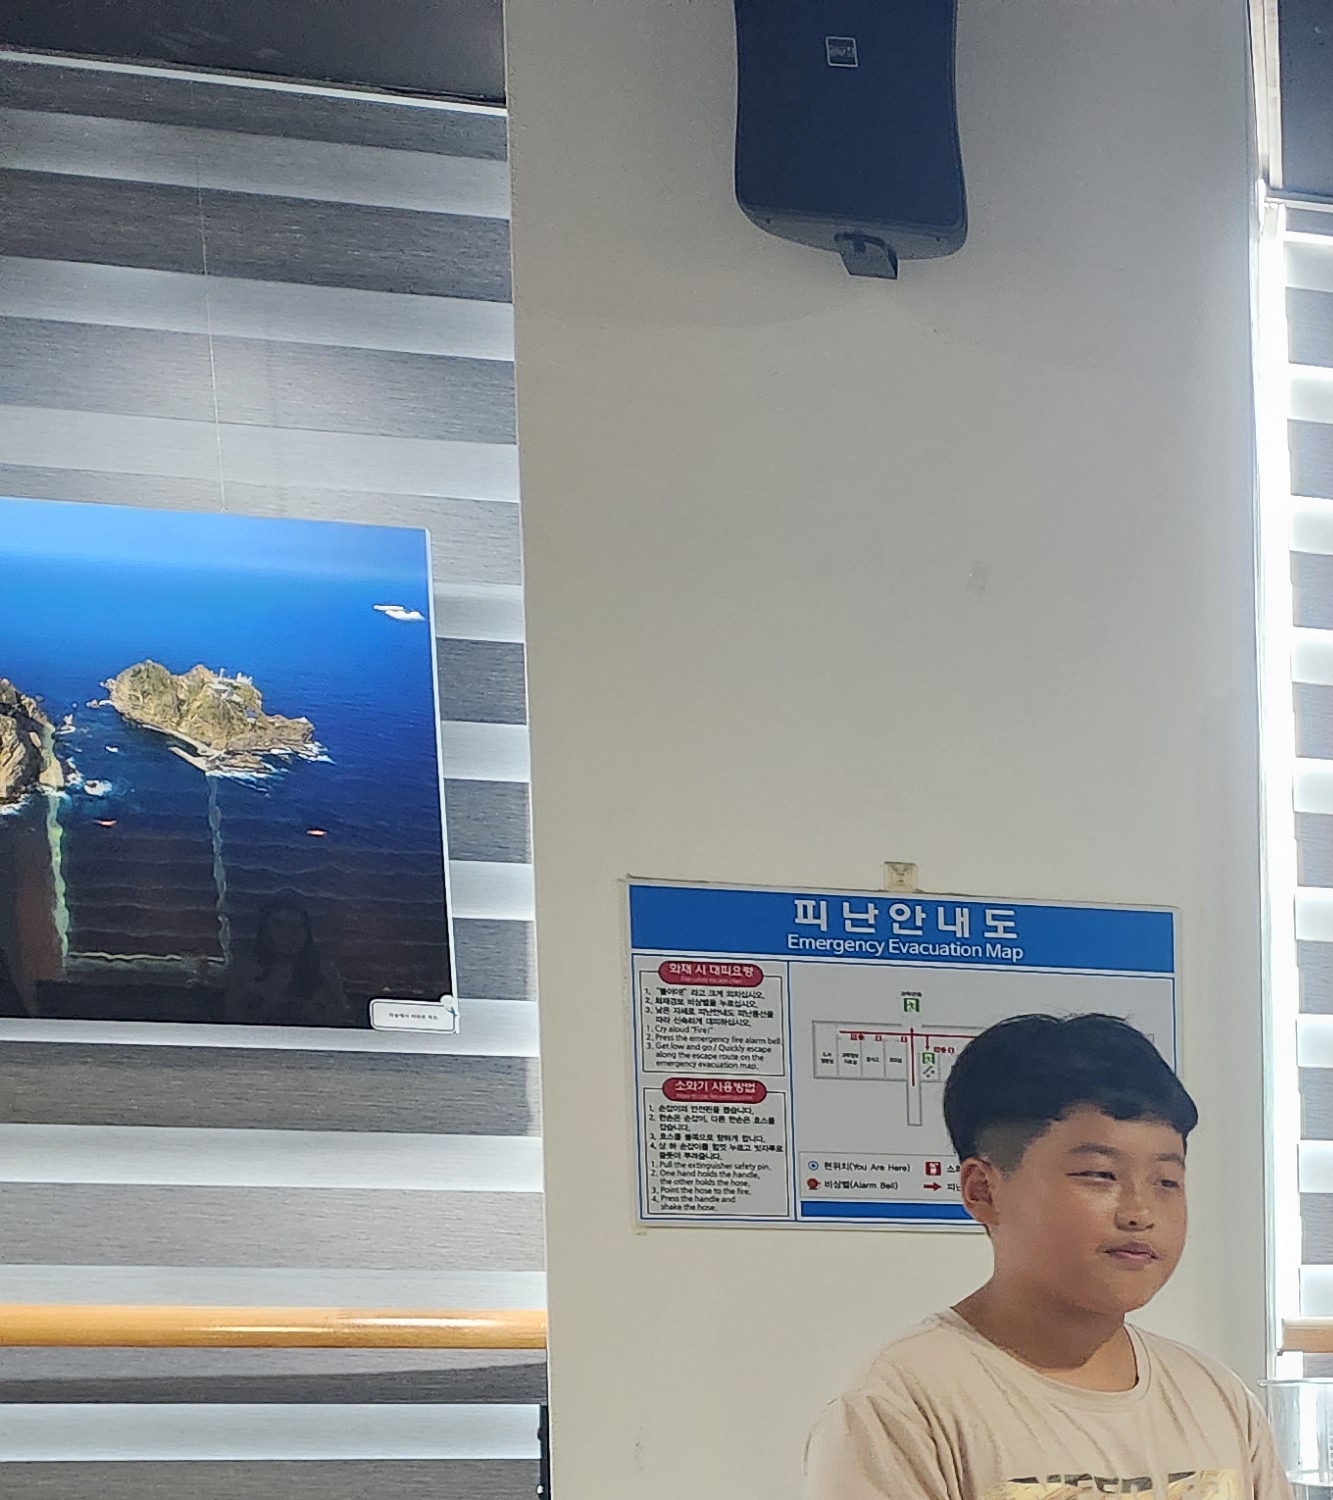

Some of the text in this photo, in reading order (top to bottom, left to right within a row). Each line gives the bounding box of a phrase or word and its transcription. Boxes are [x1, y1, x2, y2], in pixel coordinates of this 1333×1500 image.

[787, 933, 1023, 963] Emergency Evacuation Map
[669, 963, 692, 976] 화재
[694, 964, 707, 976] 시
